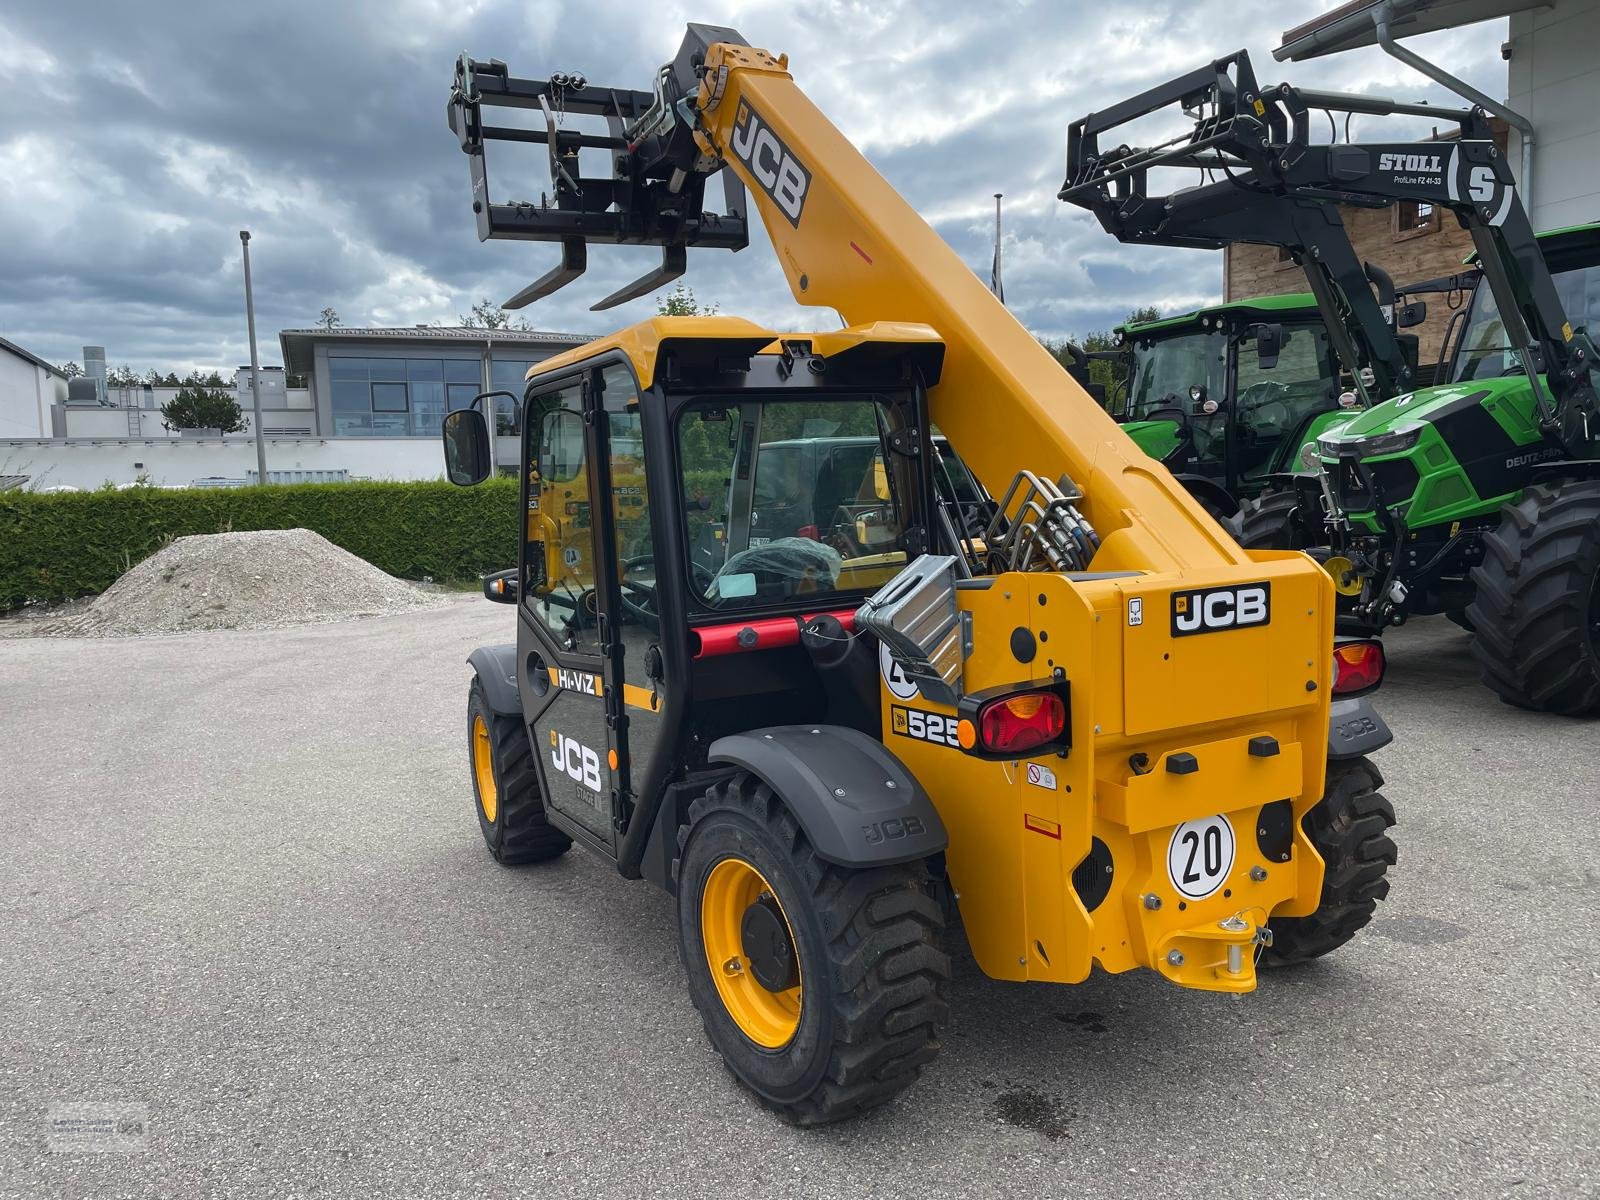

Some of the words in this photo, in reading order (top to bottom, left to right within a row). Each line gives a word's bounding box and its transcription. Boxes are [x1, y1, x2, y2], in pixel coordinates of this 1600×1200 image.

[733, 115, 807, 219] JCB
[1378, 153, 1442, 173] STOLL
[1417, 176, 1426, 185] FZ
[1176, 588, 1267, 631] JCB
[908, 710, 960, 748] 525
[1341, 717, 1378, 742] JCB
[551, 733, 602, 793] JCB
[576, 785, 595, 807] STAGE
[864, 816, 927, 846] JCB
[1182, 825, 1222, 885] 20
